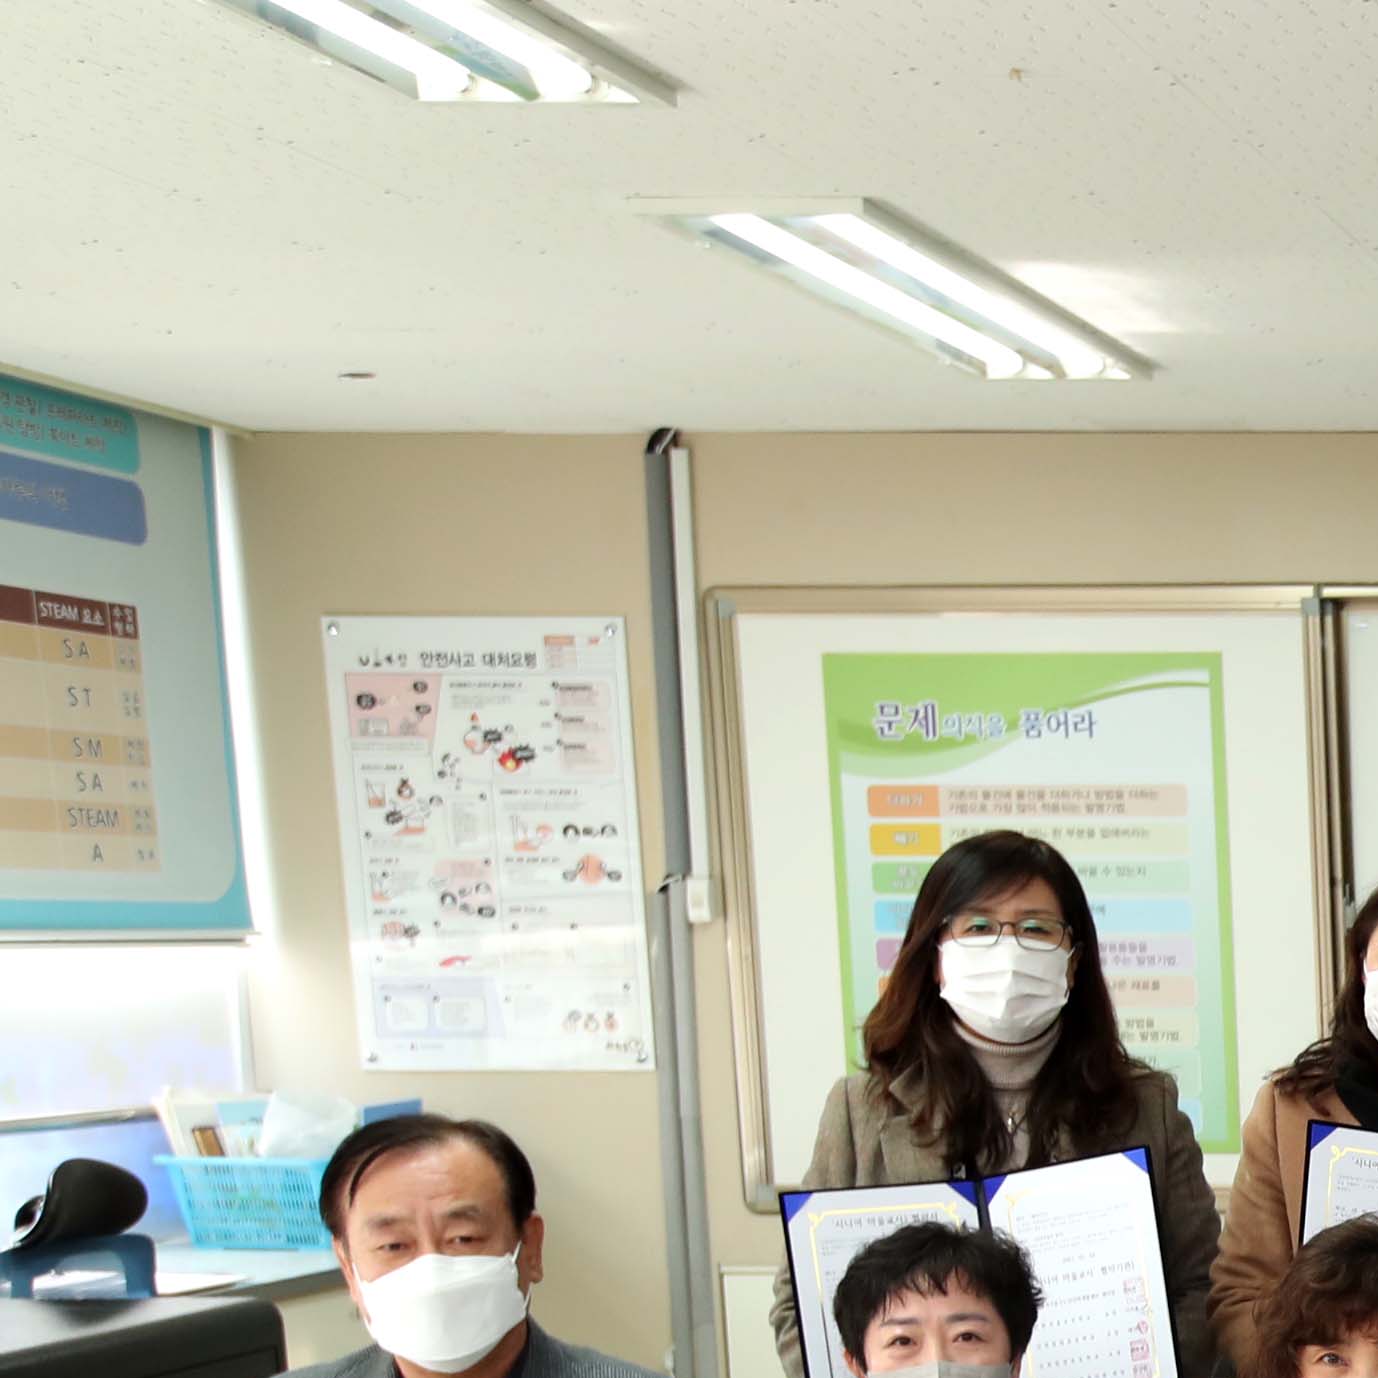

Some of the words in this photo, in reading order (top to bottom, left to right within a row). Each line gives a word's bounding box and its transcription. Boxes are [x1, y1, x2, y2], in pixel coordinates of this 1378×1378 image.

[40, 601, 80, 621] STEAM
[419, 651, 476, 668] 안전사고
[482, 652, 537, 668] 대처요령
[1021, 709, 1097, 738] 품어라
[67, 807, 119, 828] STEAM
